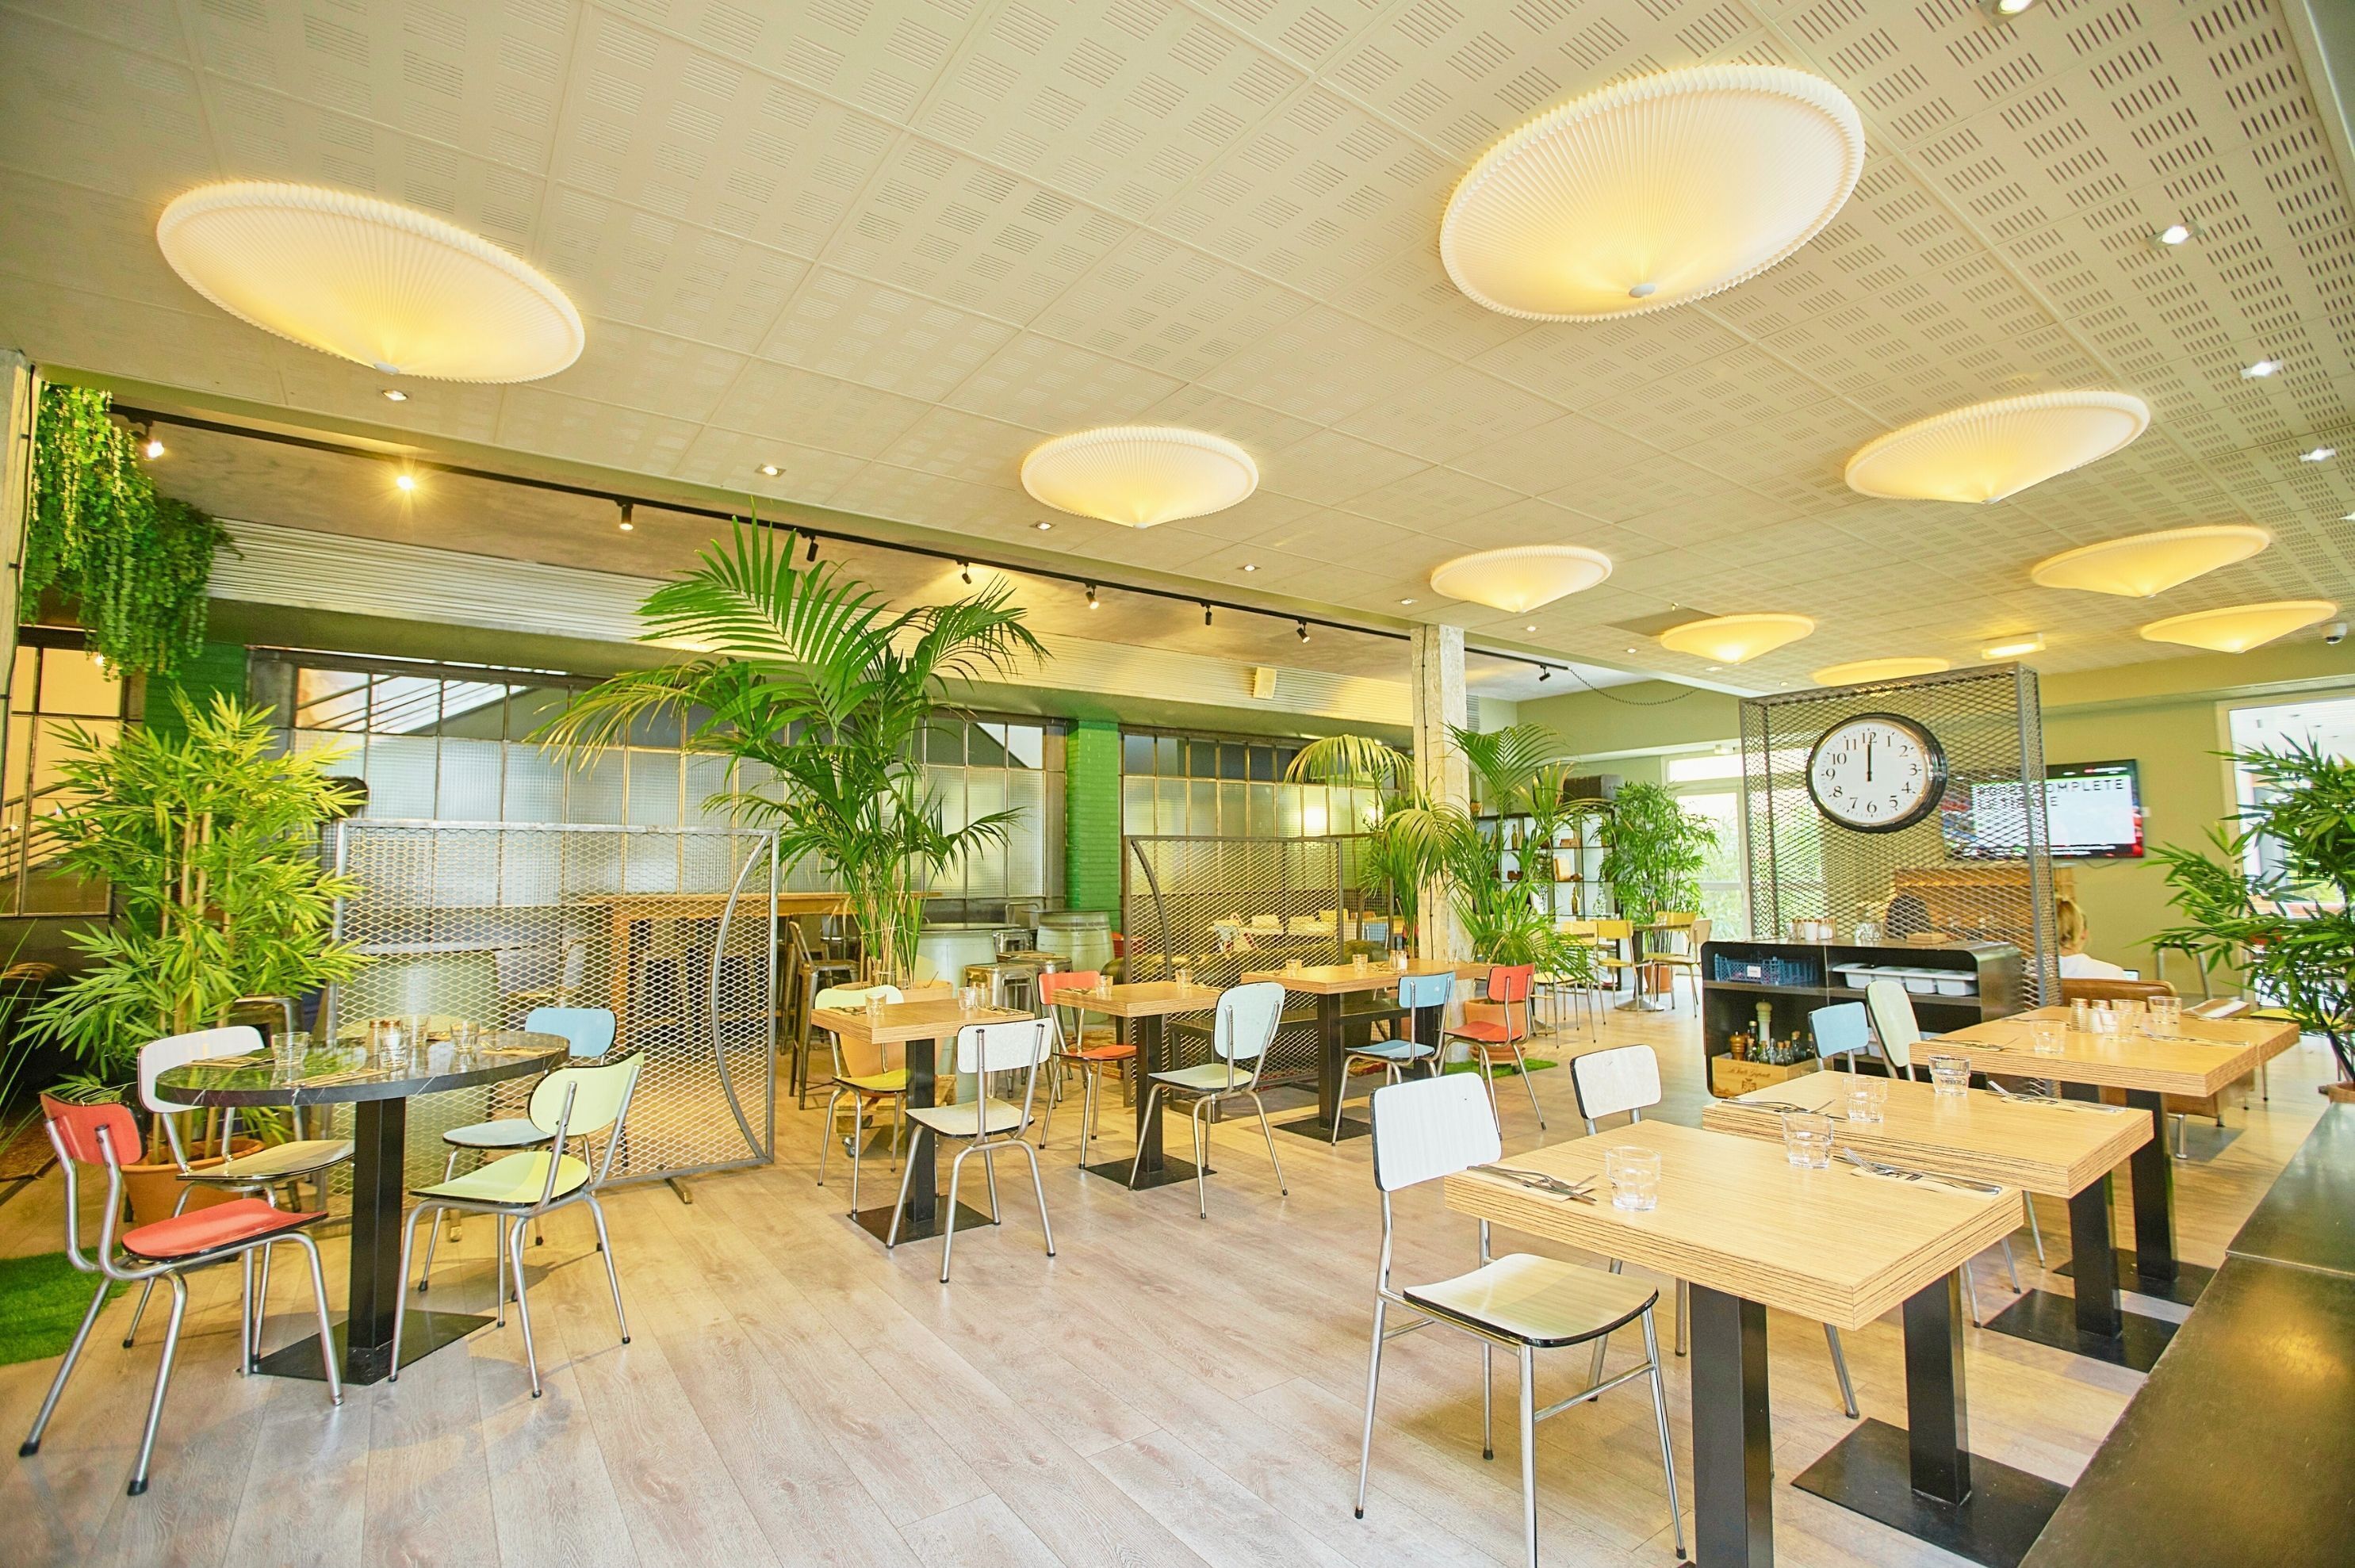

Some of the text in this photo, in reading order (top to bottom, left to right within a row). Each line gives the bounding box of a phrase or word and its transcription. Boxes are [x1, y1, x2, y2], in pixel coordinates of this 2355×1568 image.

[1862, 731, 1878, 744] 12
[1886, 735, 1891, 748] 1
[1845, 738, 1857, 751] 11
[1898, 744, 1909, 757] 2
[1832, 752, 1847, 765] 10
[1825, 767, 1836, 781] 9
[1909, 763, 1917, 776] 3
[1832, 786, 1843, 798] 8
[1901, 781, 1912, 794] 4
[1849, 797, 1859, 809] 7
[1867, 800, 1877, 813] 6
[1889, 794, 1898, 808] 5
